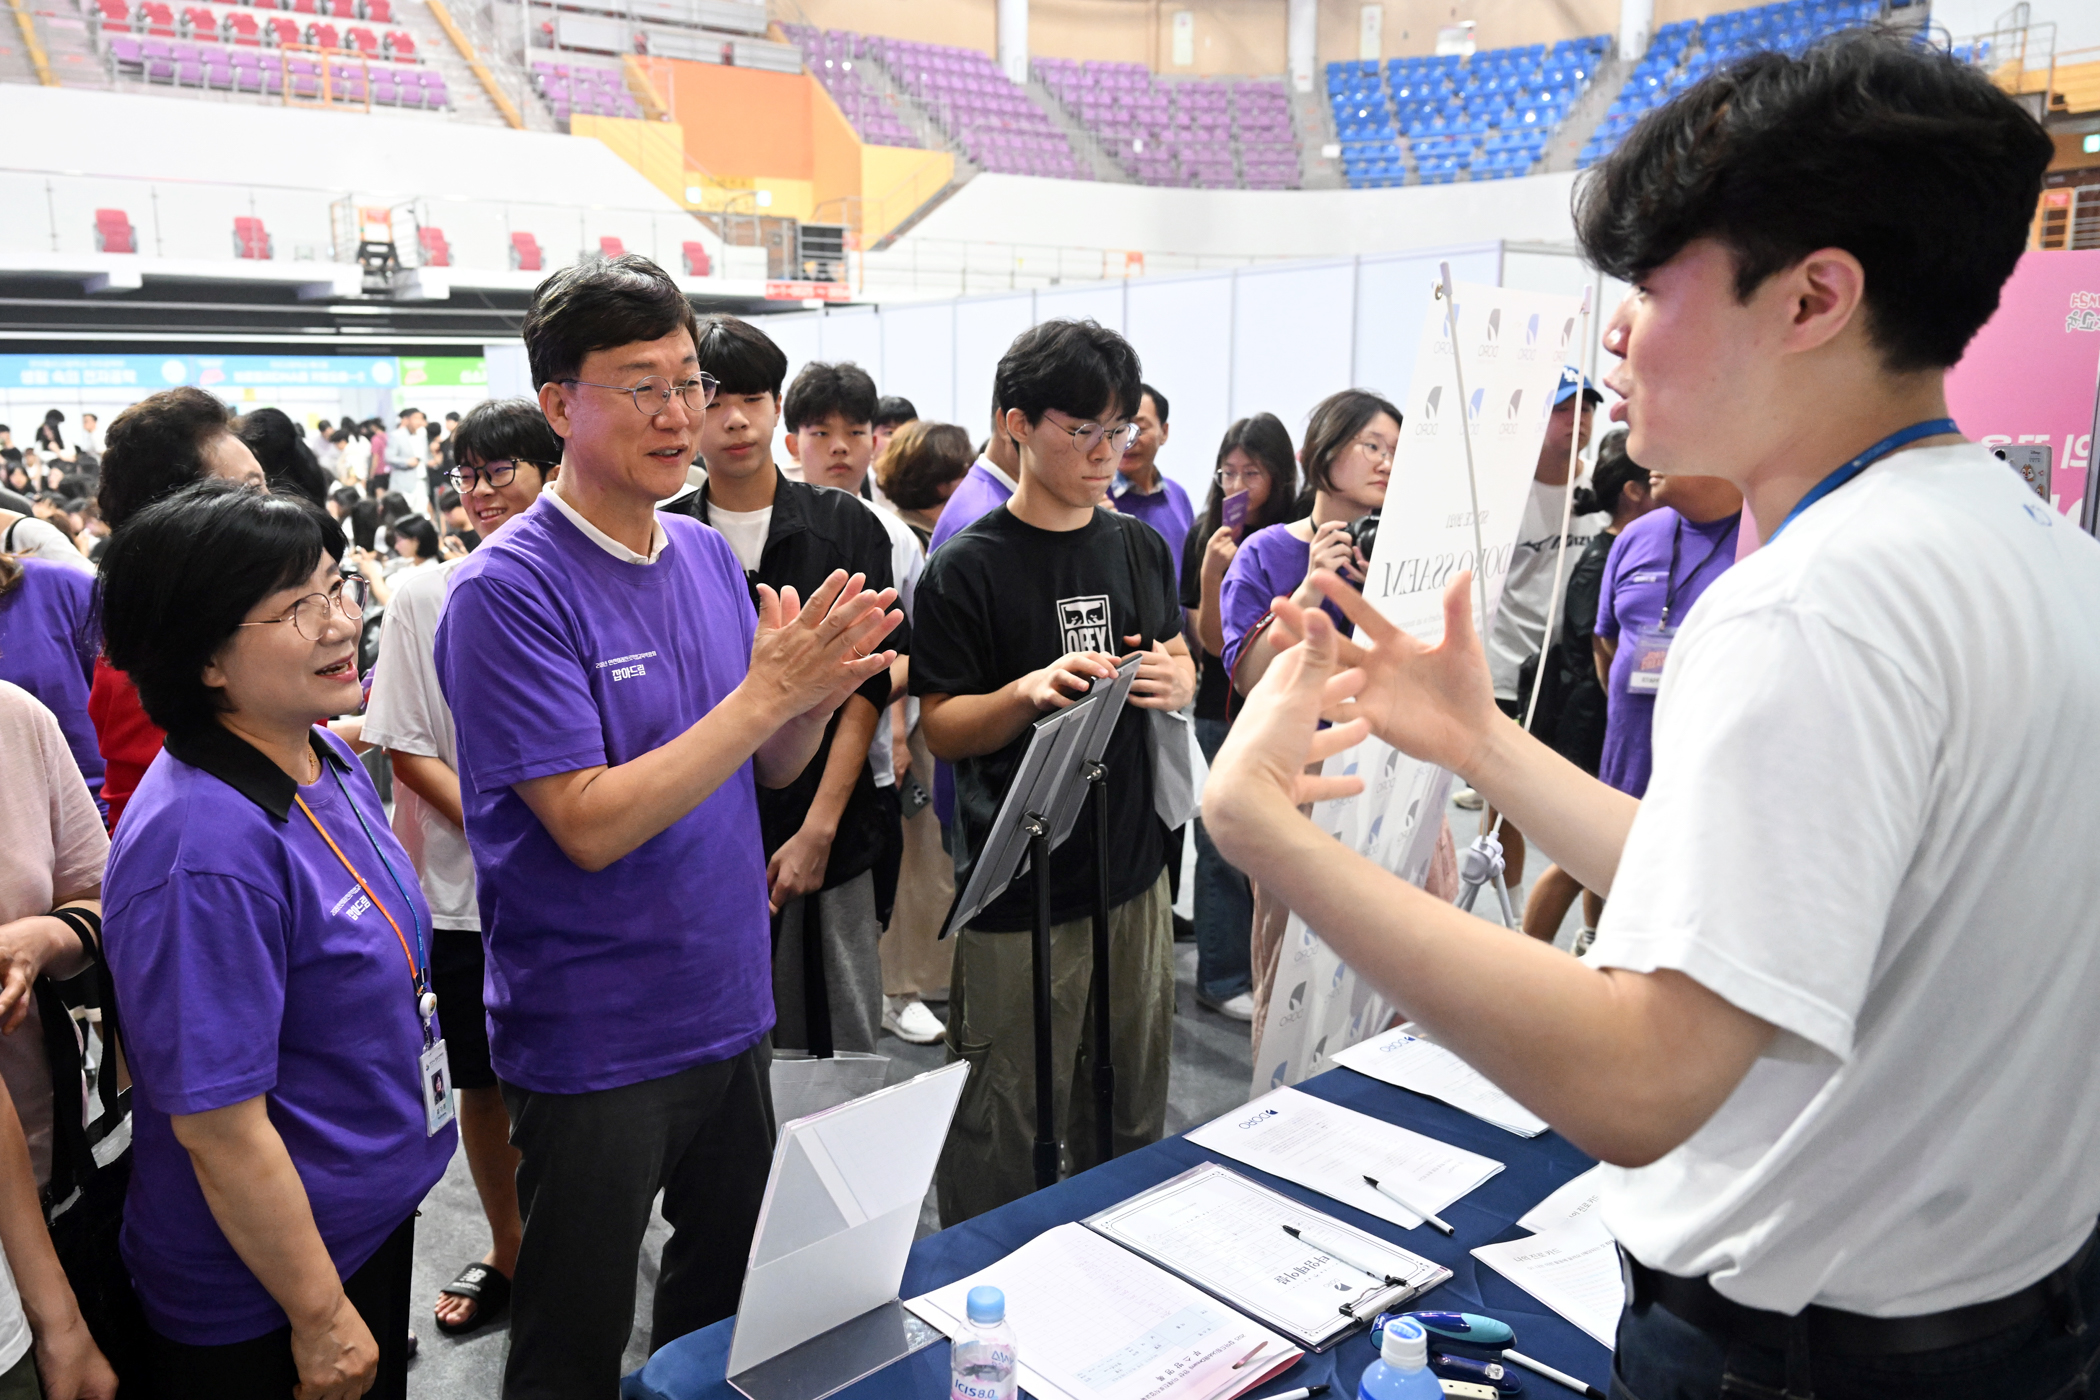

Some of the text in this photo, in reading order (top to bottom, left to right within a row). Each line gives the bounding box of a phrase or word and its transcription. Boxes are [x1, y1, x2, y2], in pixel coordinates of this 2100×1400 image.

[1066, 626, 1106, 652] OBEY
[612, 664, 646, 682] 잡아드림
[346, 895, 372, 921] 잡아드림
[1380, 1038, 1408, 1052] DORO
[1239, 1111, 1271, 1130] DORO
[1514, 1247, 1562, 1264] 나의 진로 카드
[1274, 1255, 1330, 1286] 타임테이블
[1178, 1368, 1190, 1380] 안산
